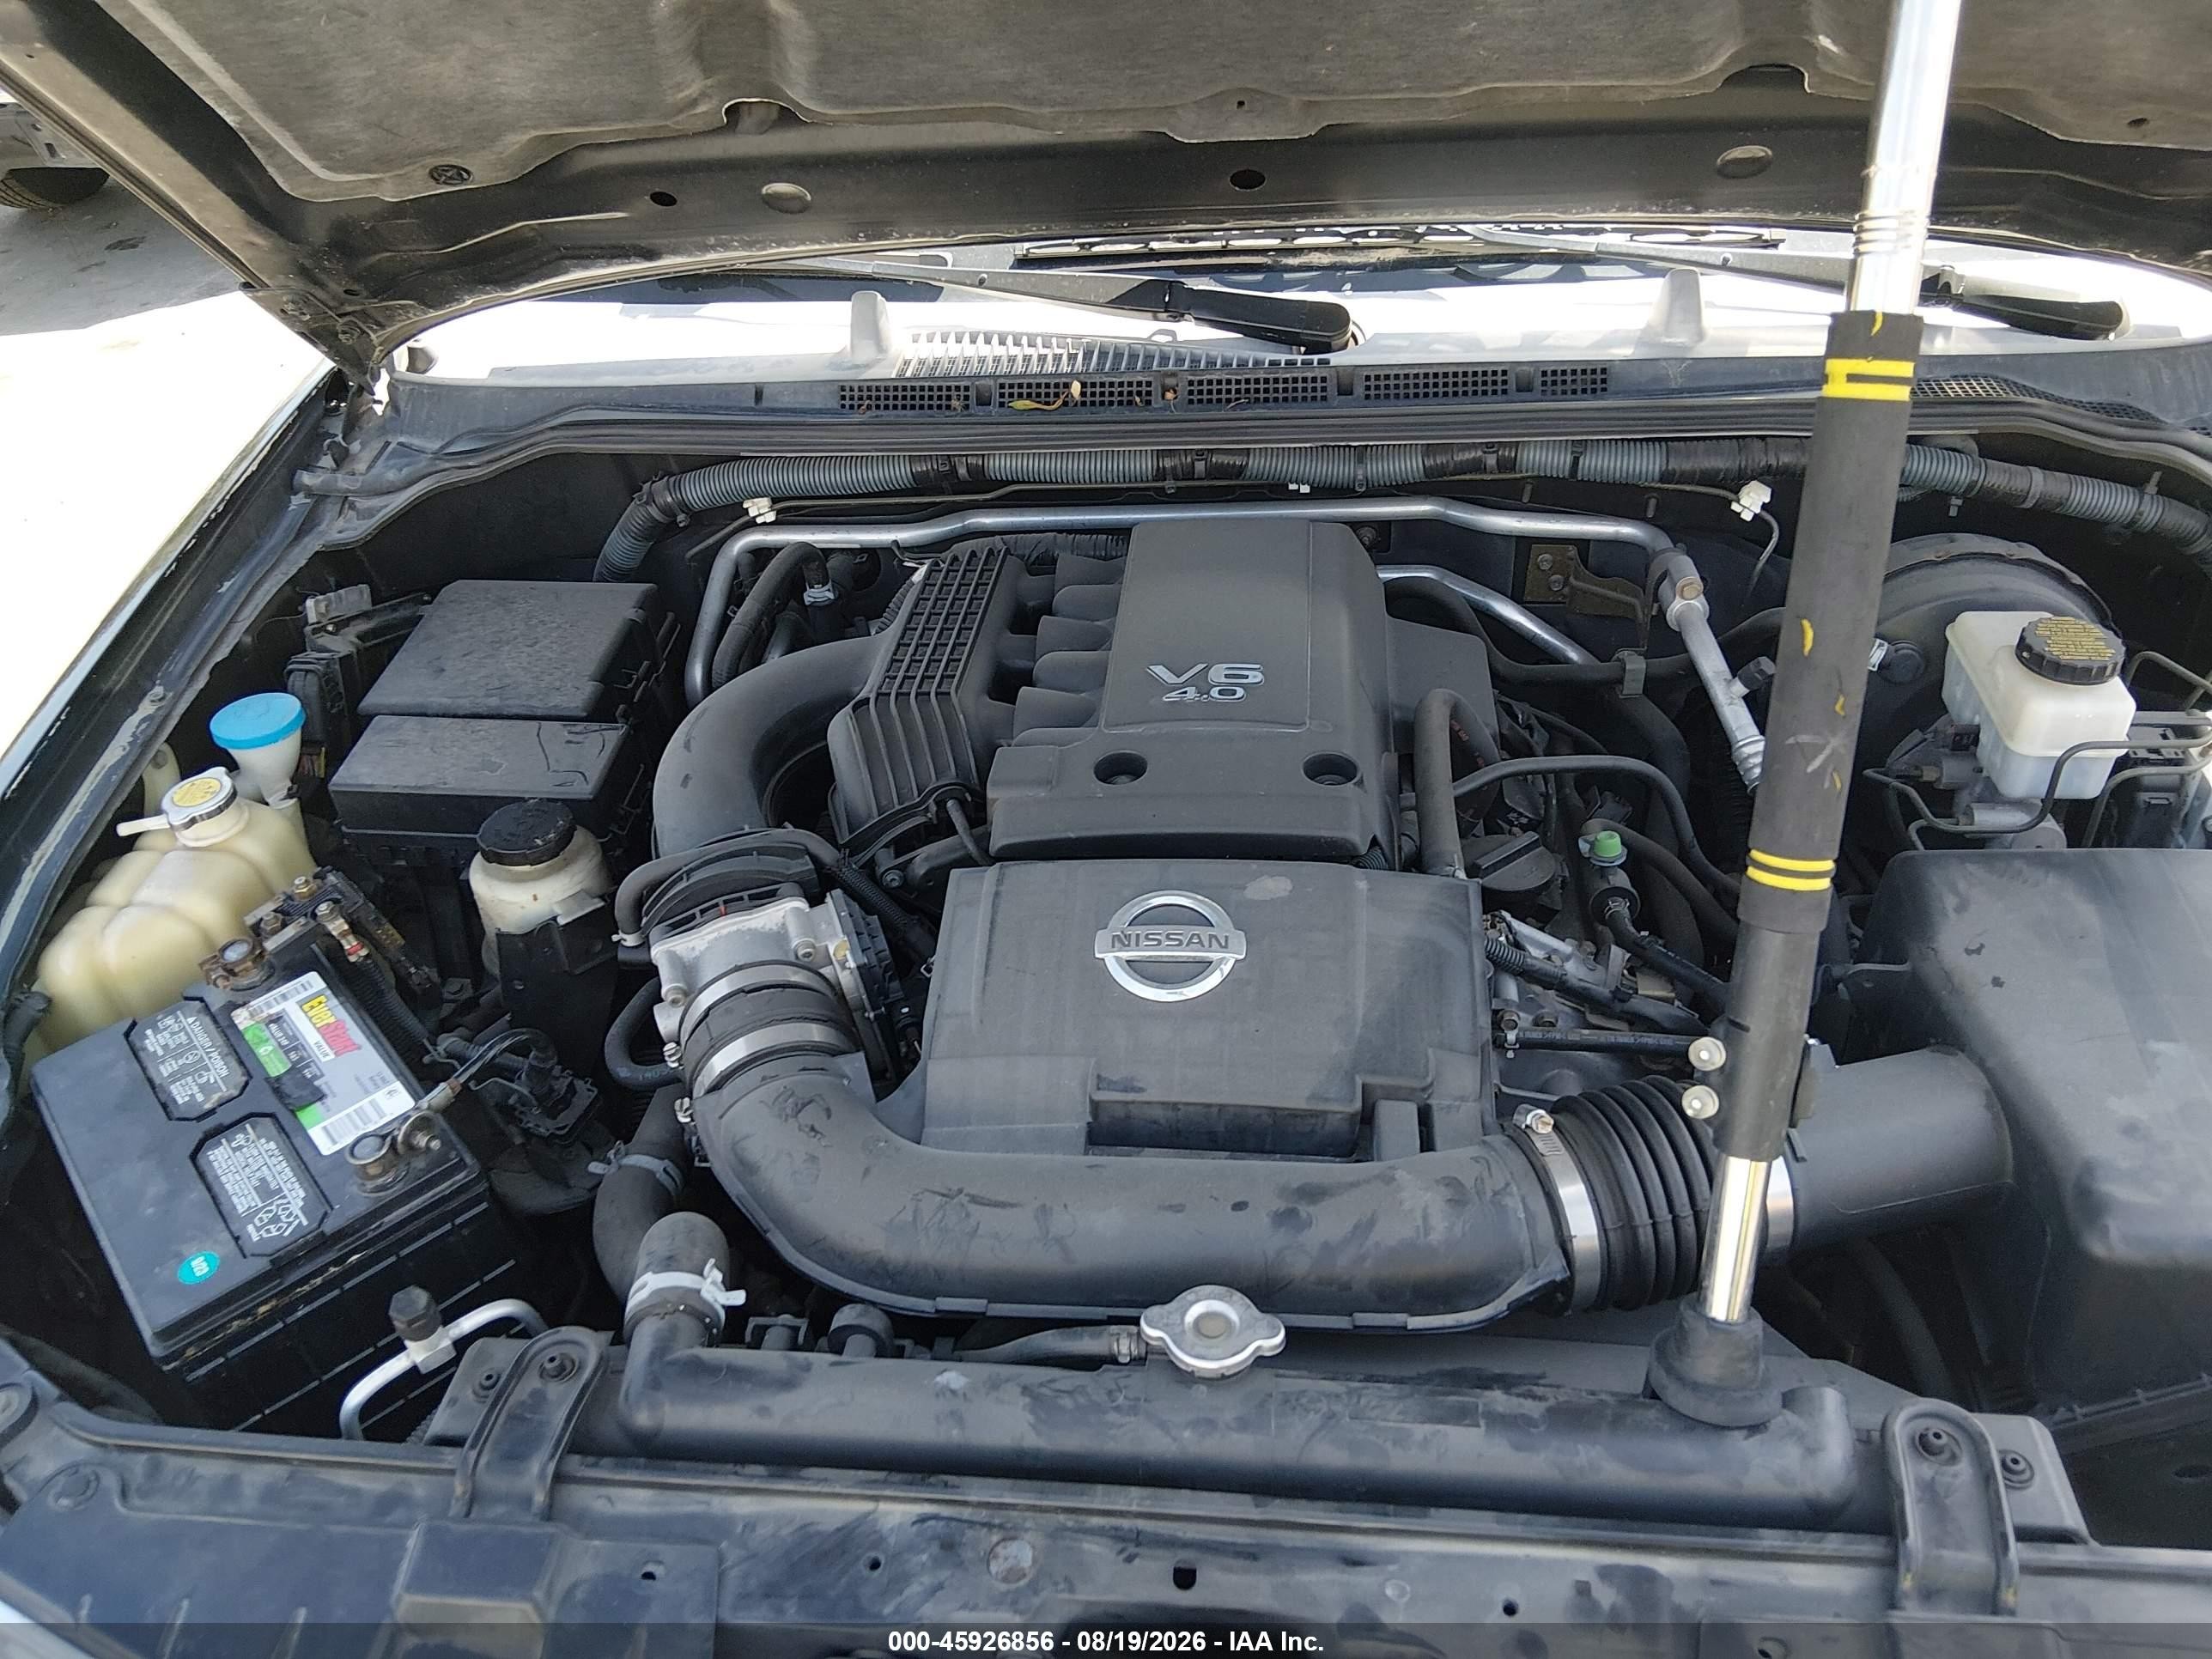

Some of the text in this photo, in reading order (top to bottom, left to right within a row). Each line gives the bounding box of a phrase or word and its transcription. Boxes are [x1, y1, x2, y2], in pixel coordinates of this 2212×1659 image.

[1146, 663, 1264, 685] V6
[1163, 686, 1246, 702] 4.0
[1110, 930, 1230, 950] NISSAN
